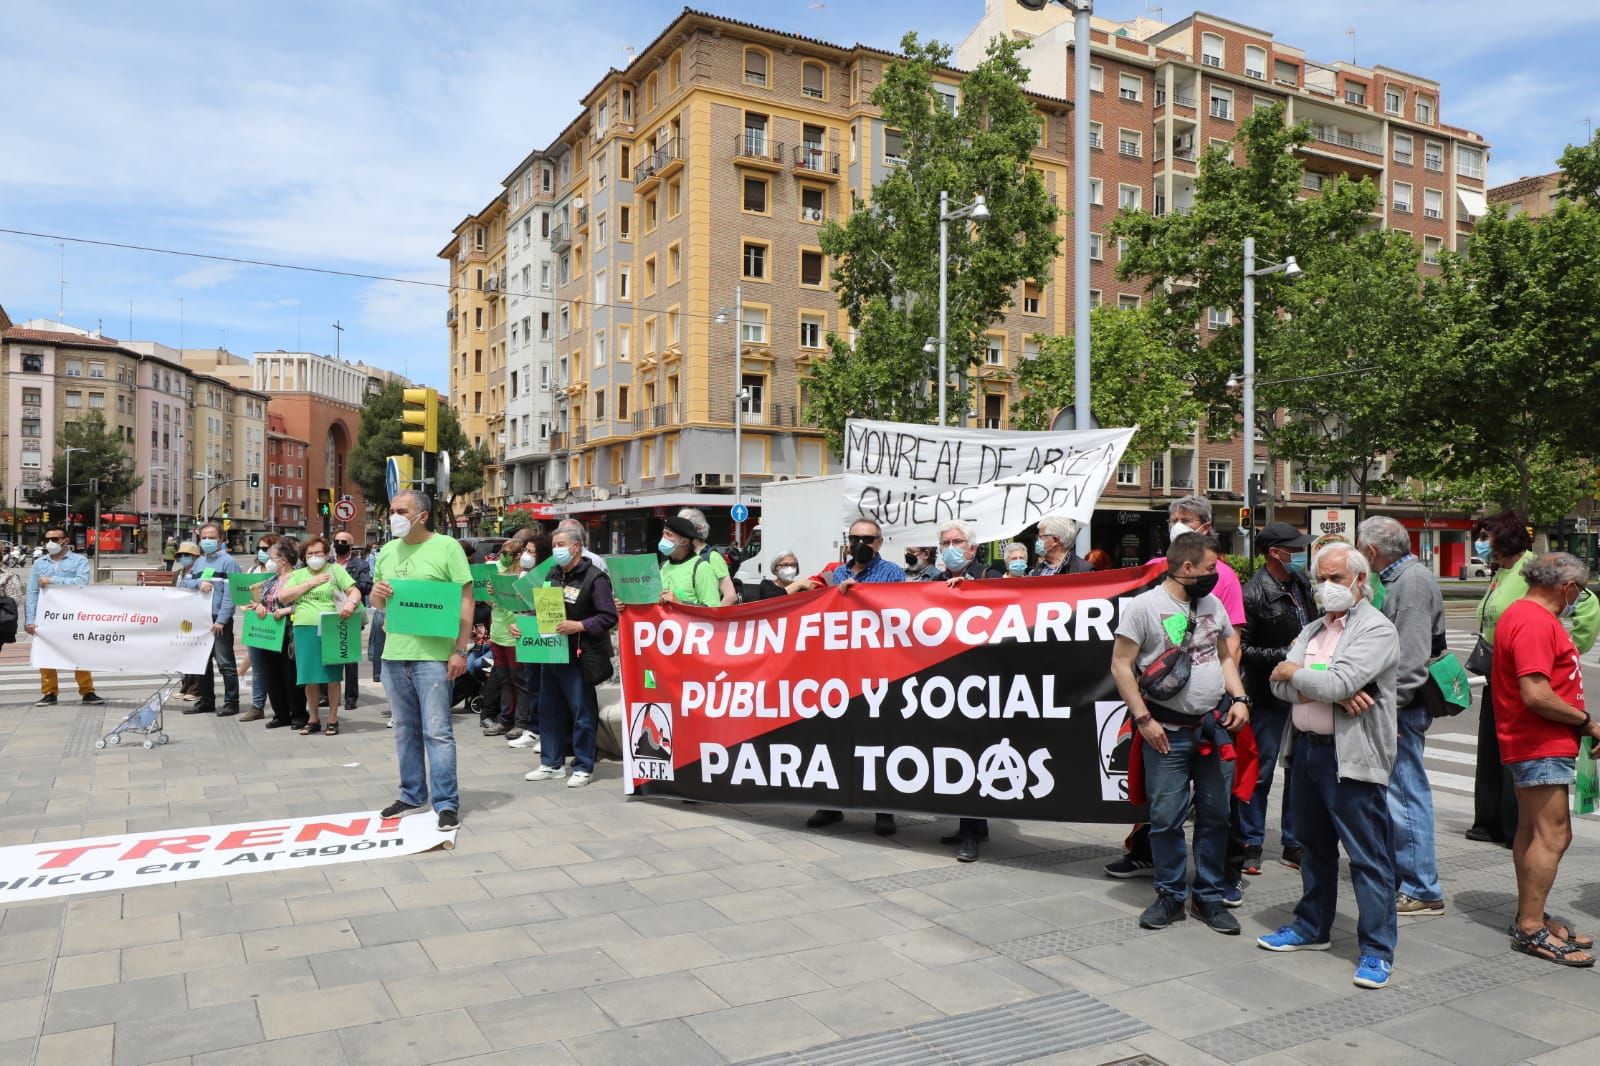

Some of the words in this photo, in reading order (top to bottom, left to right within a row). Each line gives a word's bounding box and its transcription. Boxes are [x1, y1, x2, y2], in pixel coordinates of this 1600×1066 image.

[847, 424, 968, 485] MONREAL
[978, 444, 1017, 485] DE
[994, 475, 1091, 524] TREN
[44, 610, 60, 620] Por
[62, 611, 74, 620] un
[77, 612, 128, 622] ferrocarril
[129, 613, 159, 625] digno
[399, 601, 443, 610] BARBASTRO
[72, 632, 85, 641] en
[88, 631, 125, 643] Aragón
[633, 619, 714, 656] POR
[724, 617, 788, 655] UN
[680, 670, 850, 719] PÚBLICO
[861, 677, 889, 718] Y
[900, 673, 1071, 720] SOCIAL
[638, 761, 668, 780] S.F.F.
[699, 742, 839, 790] PARA
[35, 817, 402, 870] TREN!
[135, 859, 201, 875] en
[223, 837, 404, 866] Aragón
